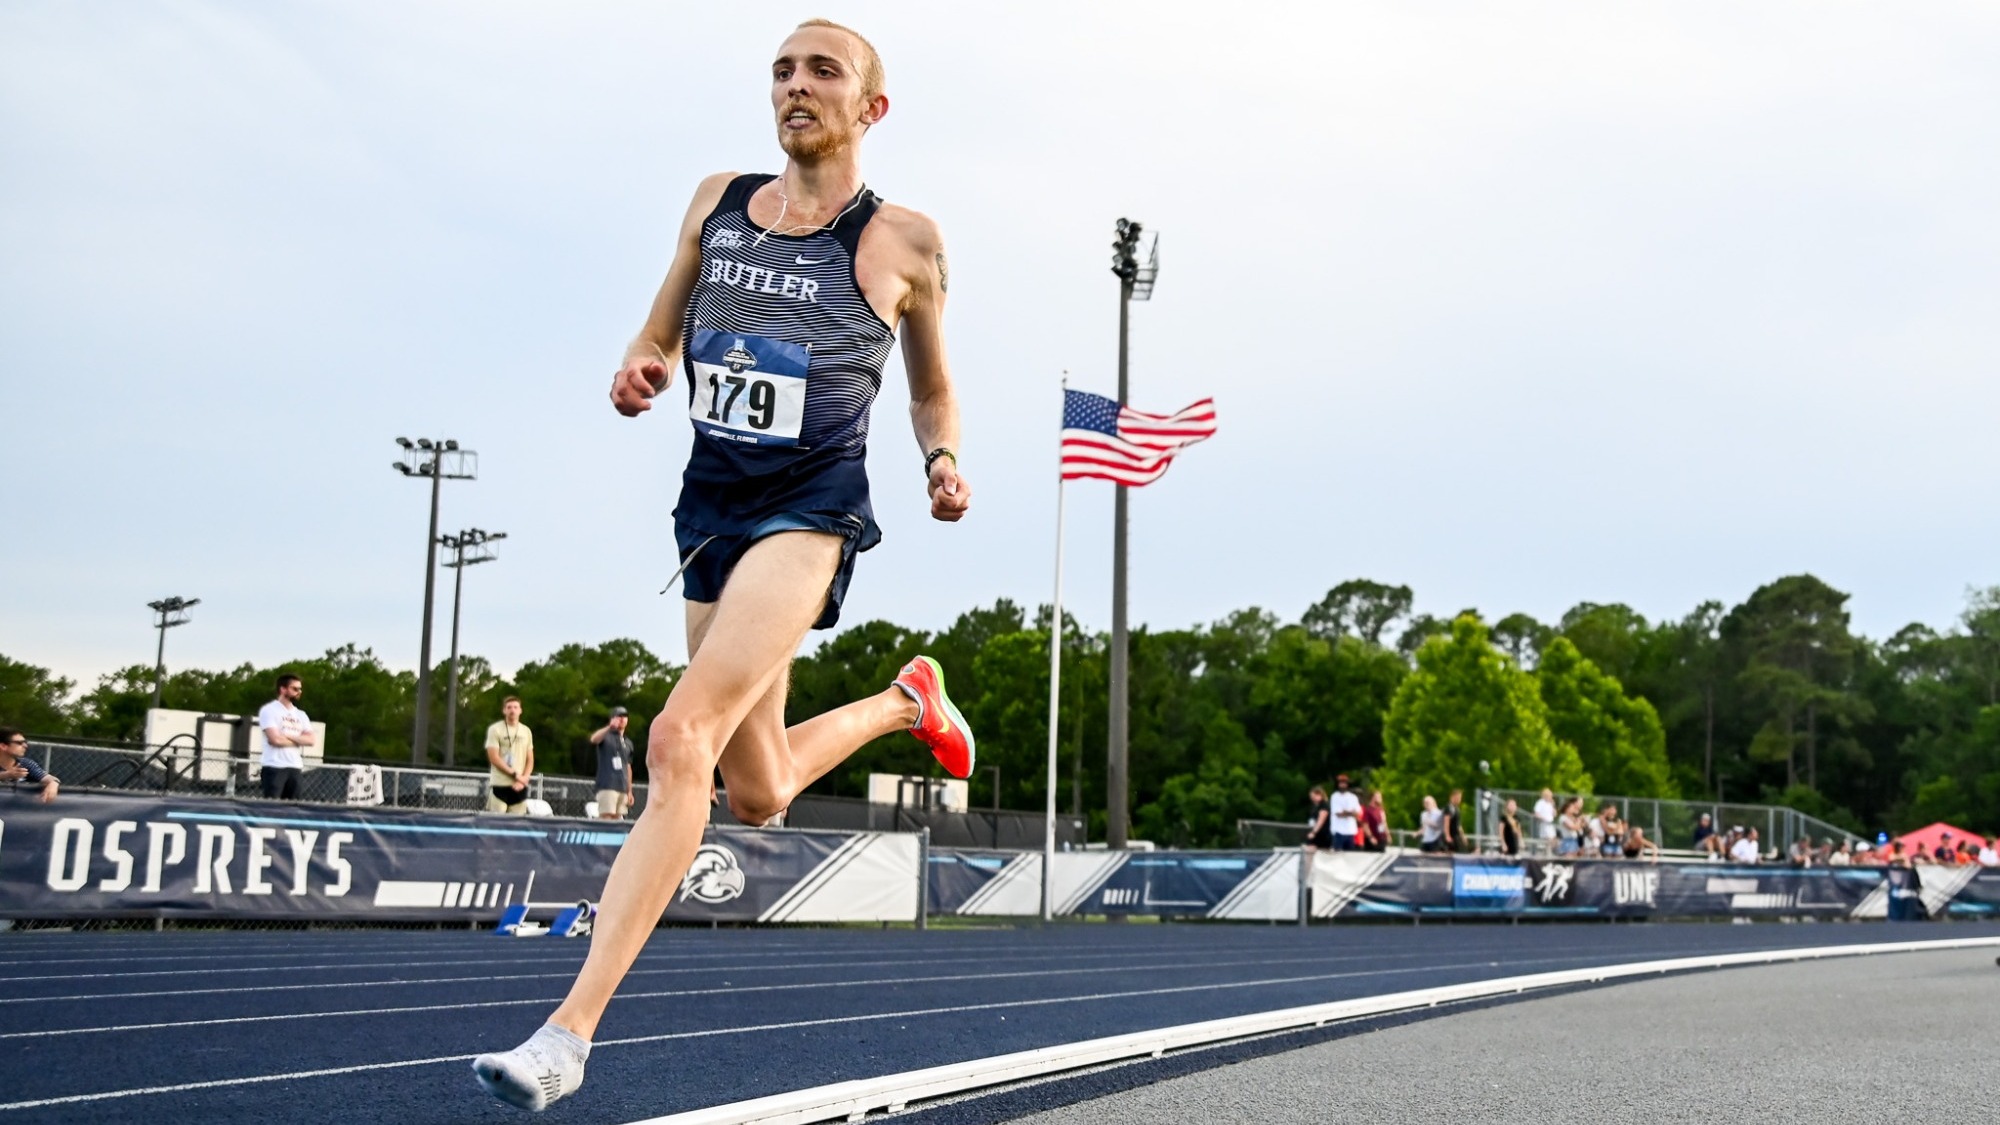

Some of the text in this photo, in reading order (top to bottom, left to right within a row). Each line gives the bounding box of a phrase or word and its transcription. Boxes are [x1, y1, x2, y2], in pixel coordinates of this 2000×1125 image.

[708, 237, 746, 248] EAST
[716, 229, 742, 239] BIG
[709, 258, 819, 303] BUTLER
[707, 373, 776, 430] 179
[47, 818, 354, 897] OSPREYS
[1613, 870, 1659, 907] UNF
